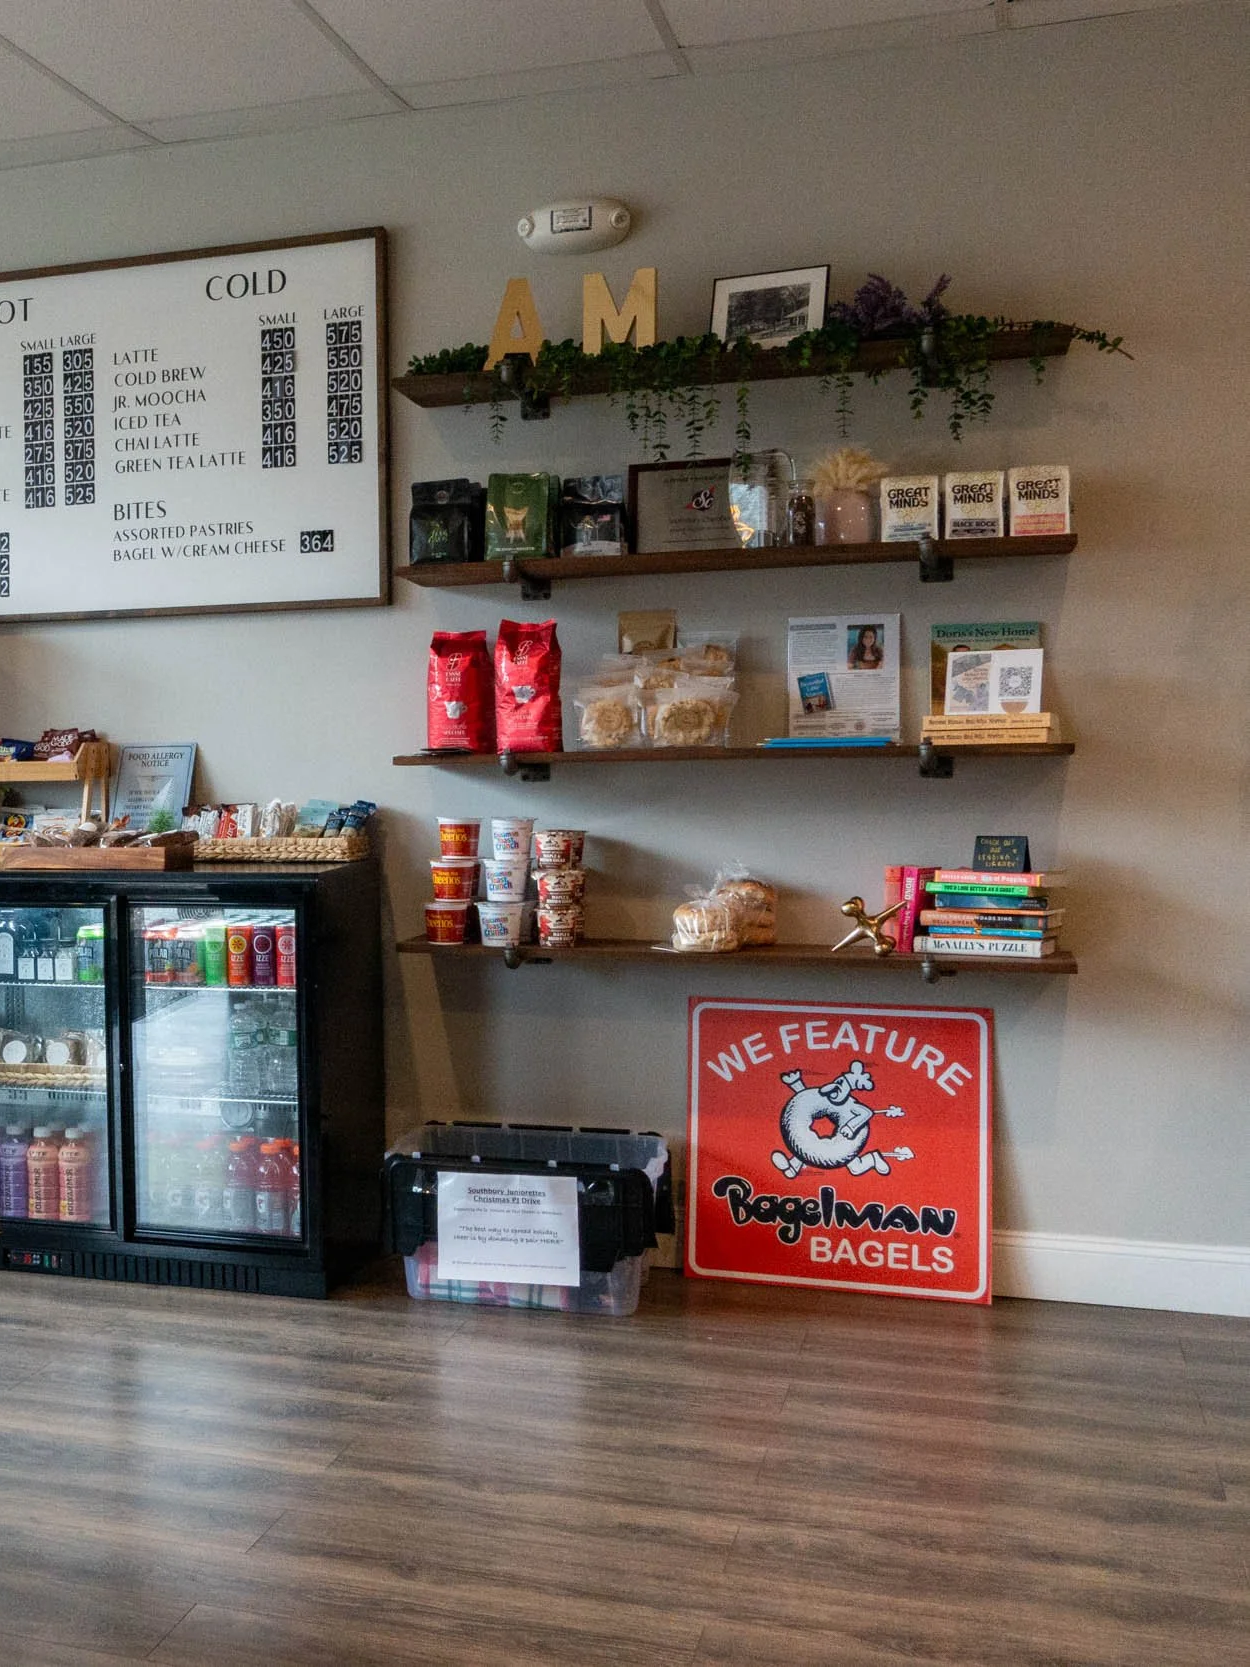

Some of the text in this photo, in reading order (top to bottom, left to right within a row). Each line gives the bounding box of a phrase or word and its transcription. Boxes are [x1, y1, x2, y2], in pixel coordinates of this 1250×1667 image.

[205, 269, 287, 301] COLD
[258, 305, 366, 326] SMALL LARGE
[20, 333, 97, 352] SMALL LARGE
[113, 323, 362, 365] LATTE 450 575
[24, 355, 52, 375] 155
[63, 350, 93, 371] 305
[114, 347, 362, 387] COLD BREW 425 550
[24, 377, 53, 398] 350
[63, 372, 93, 393] 425
[111, 371, 362, 413] JR. MOOCHA 416 520
[24, 399, 53, 419] 425
[64, 395, 94, 416] 550
[114, 397, 362, 430] ICED TEA 350 475
[24, 422, 54, 442] 416
[64, 417, 94, 438] 520
[115, 418, 362, 452] CHAI LATTE 416 520
[24, 445, 54, 464] 275
[65, 441, 95, 460] 375
[115, 442, 362, 473] GREEN TEA LATTE 416 525
[25, 467, 54, 486] 416
[65, 463, 95, 482] 520
[1016, 478, 1061, 491] GREAT
[25, 489, 55, 508] 416
[65, 485, 95, 505] 525
[887, 486, 930, 499] GREAT
[951, 482, 994, 495] GREAT
[953, 492, 994, 505] MINDS
[1018, 488, 1060, 501] MINDS
[113, 500, 167, 521] BITES
[889, 497, 929, 510] MINDS
[113, 521, 254, 543] ASSORTED PASTRIES
[113, 533, 334, 562] BAGEL W/CREAM CHEESE 364
[128, 752, 185, 761] FOOD ALLERGY
[141, 760, 170, 768] NOTICE
[933, 939, 1028, 953] McNALLY'S PUZZLE
[706, 1020, 973, 1096] WE FEATURE
[473, 1195, 510, 1204] Christmas
[521, 1197, 541, 1205] Drive
[810, 1236, 955, 1273] BAGELS
